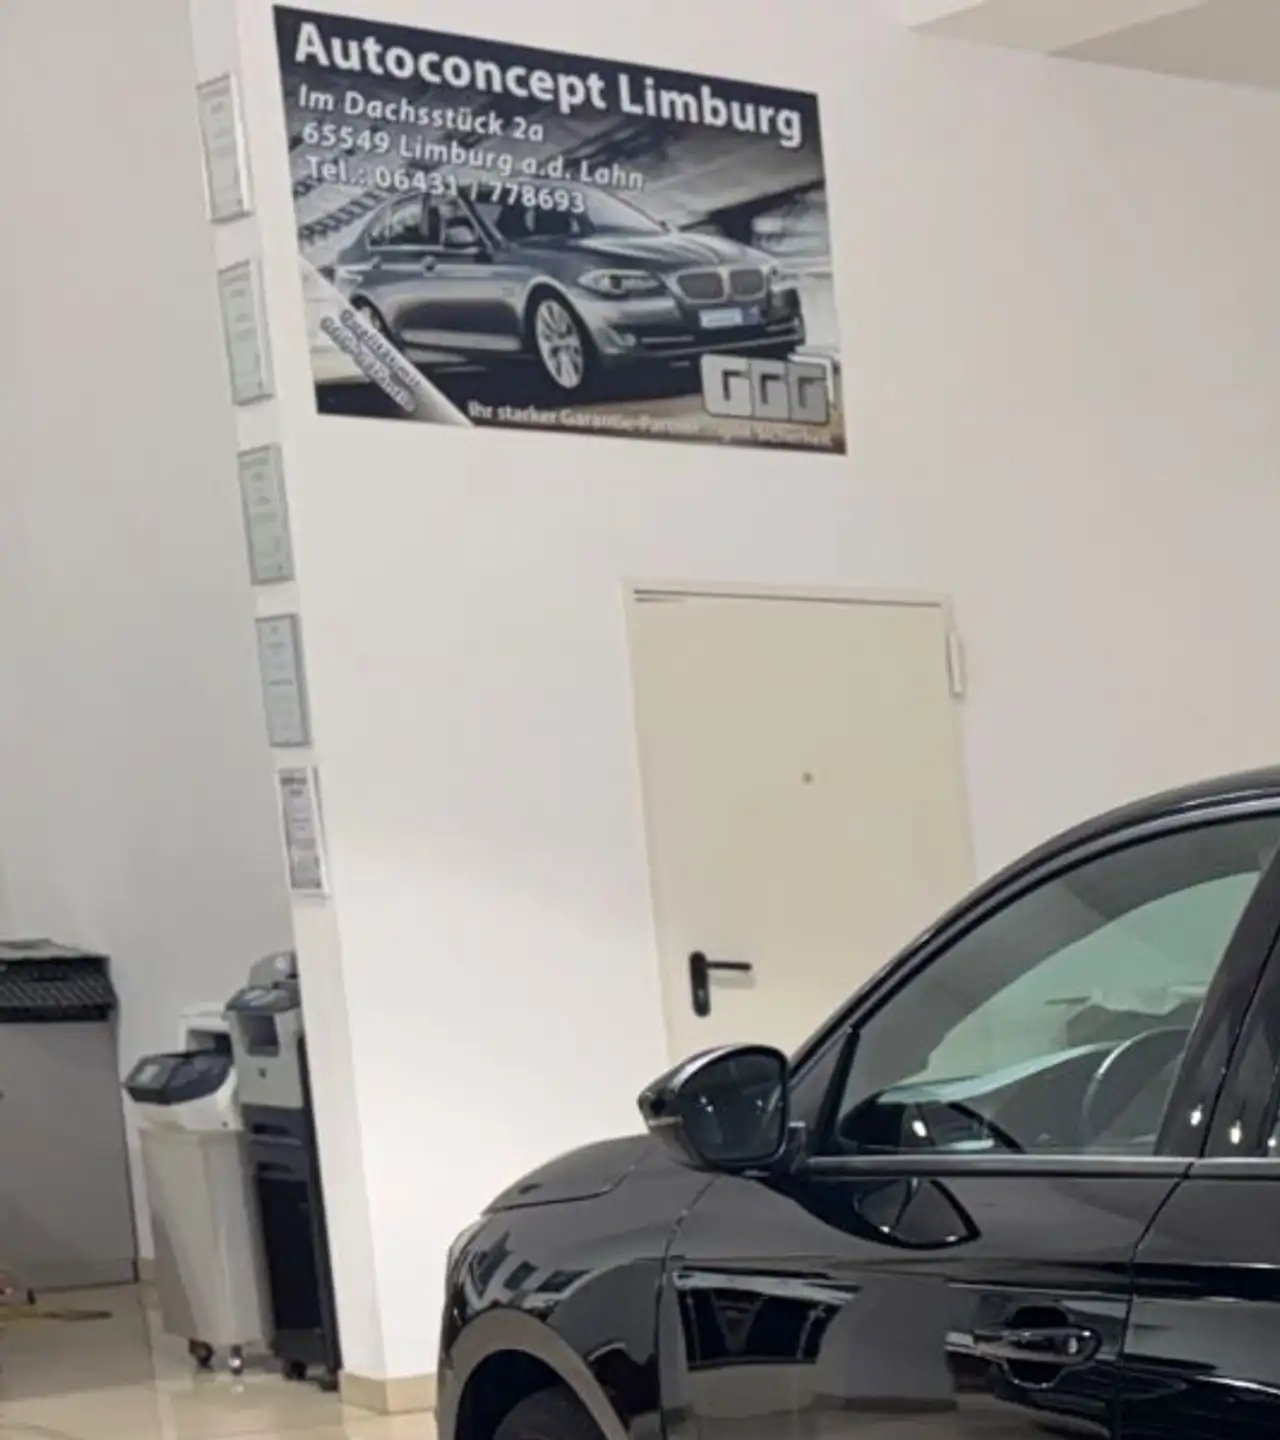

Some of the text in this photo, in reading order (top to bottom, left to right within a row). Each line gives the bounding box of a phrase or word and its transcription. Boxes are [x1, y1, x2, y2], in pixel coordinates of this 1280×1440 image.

[295, 21, 802, 149] Autoconcept Limburg
[299, 84, 544, 142] Im Dachsstück 2a
[302, 123, 390, 153] 65549
[399, 134, 513, 177] Limburg
[580, 159, 643, 189] Lahn
[376, 165, 459, 196] 06431
[491, 182, 586, 214] 778693
